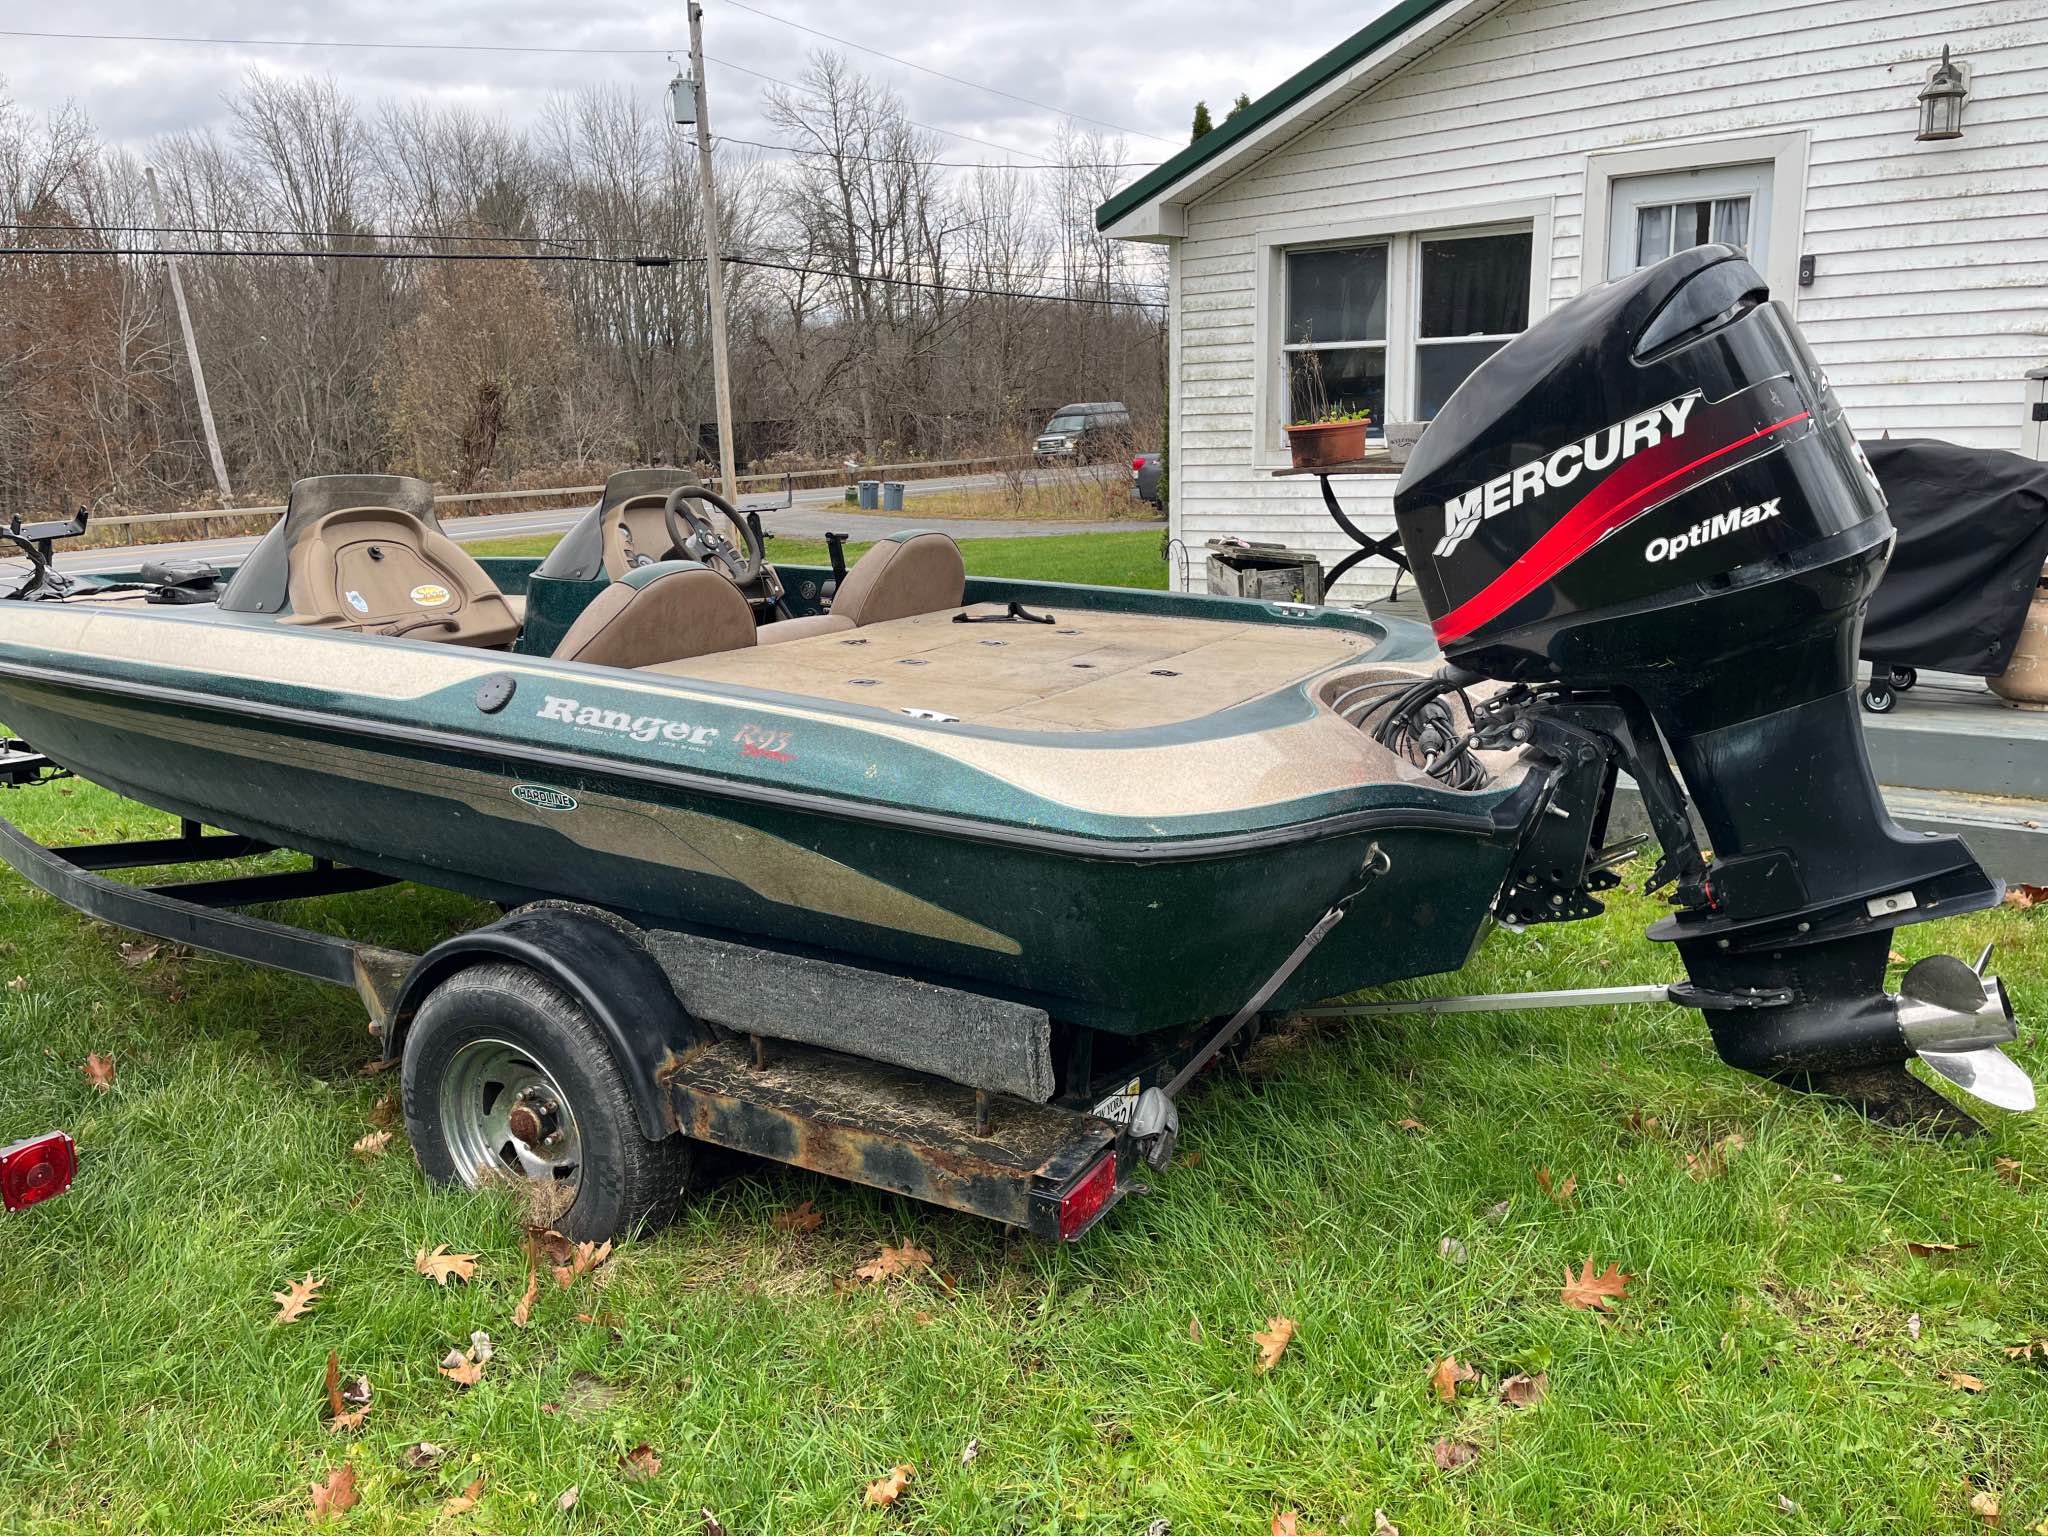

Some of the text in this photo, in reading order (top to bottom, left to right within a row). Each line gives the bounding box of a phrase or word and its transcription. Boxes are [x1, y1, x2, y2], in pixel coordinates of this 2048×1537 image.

[1434, 393, 1701, 557] MERCURY
[1645, 497, 1782, 563] OptiMax
[536, 695, 721, 745] Ranger
[518, 786, 571, 807] HARDLINE
